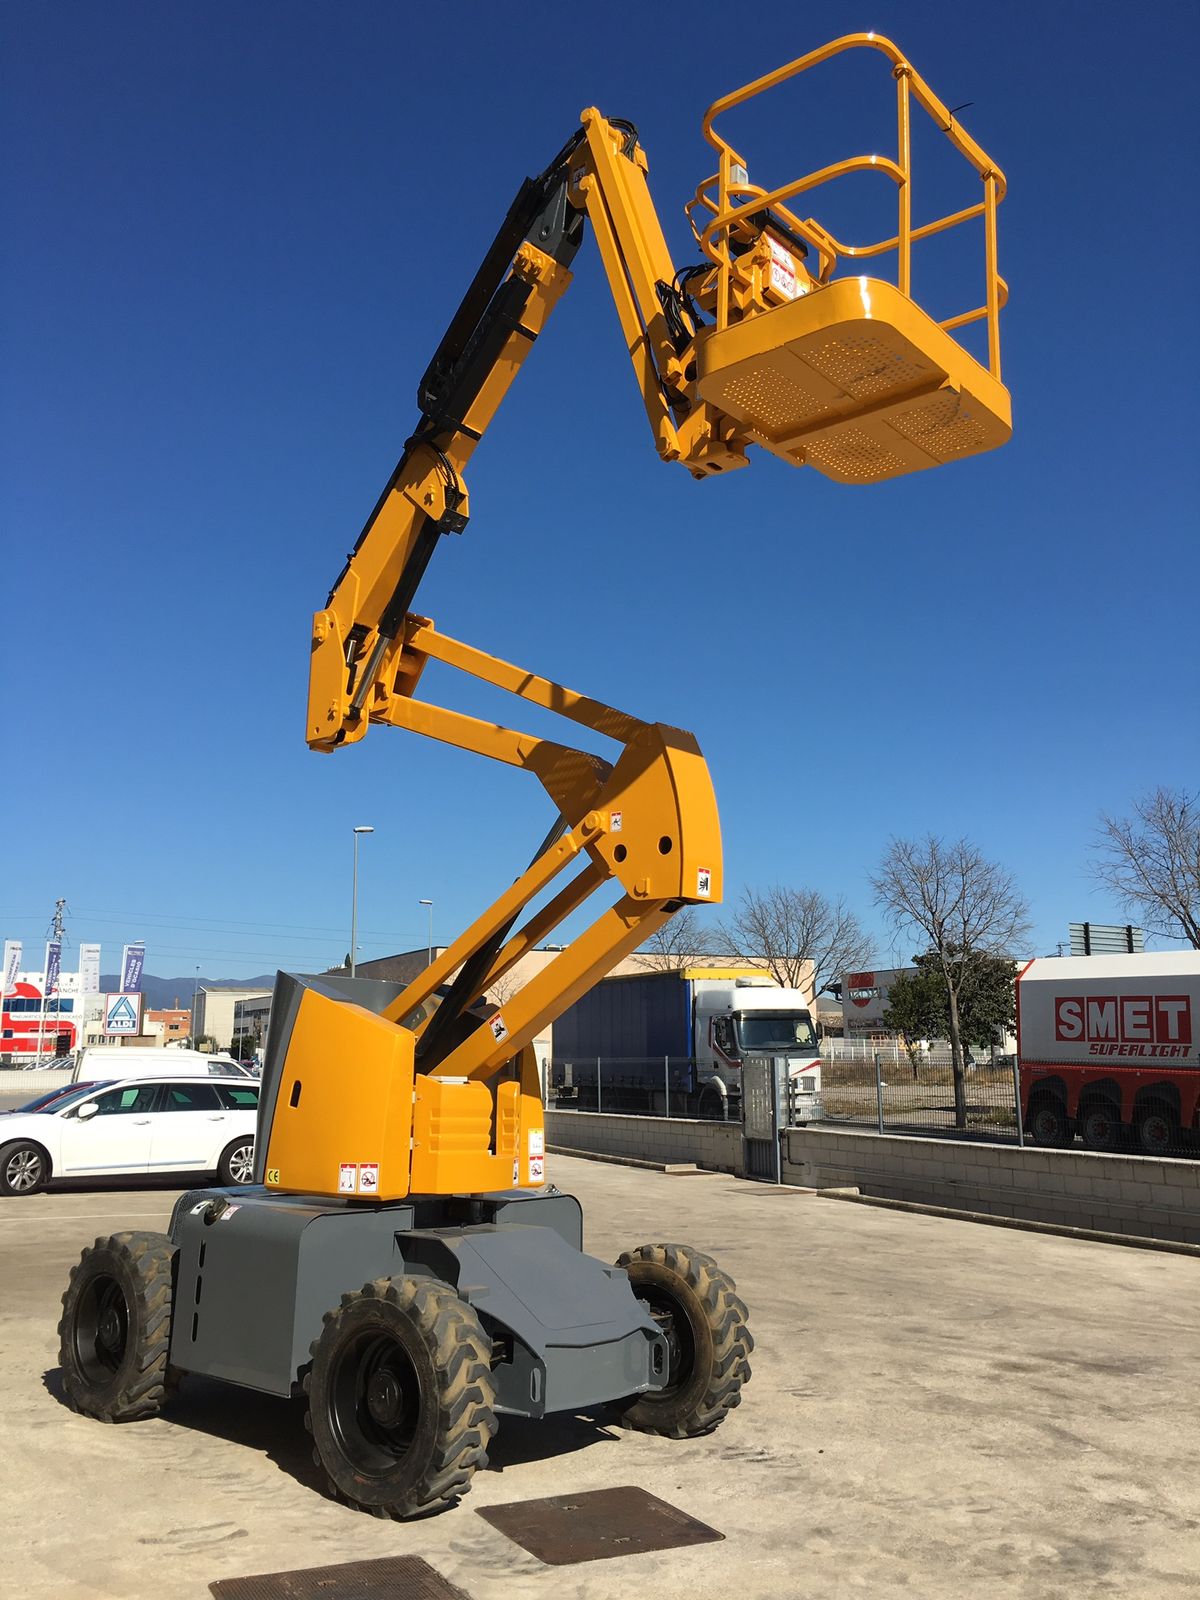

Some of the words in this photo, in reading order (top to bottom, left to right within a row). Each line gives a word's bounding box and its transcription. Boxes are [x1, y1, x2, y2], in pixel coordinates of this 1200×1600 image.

[124, 959, 137, 988] VEHICLES
[109, 1021, 133, 1029] ALDI
[1058, 999, 1189, 1041] SMET
[1089, 1044, 1192, 1057] SUPERLIGHT
[268, 1170, 278, 1182] CE
